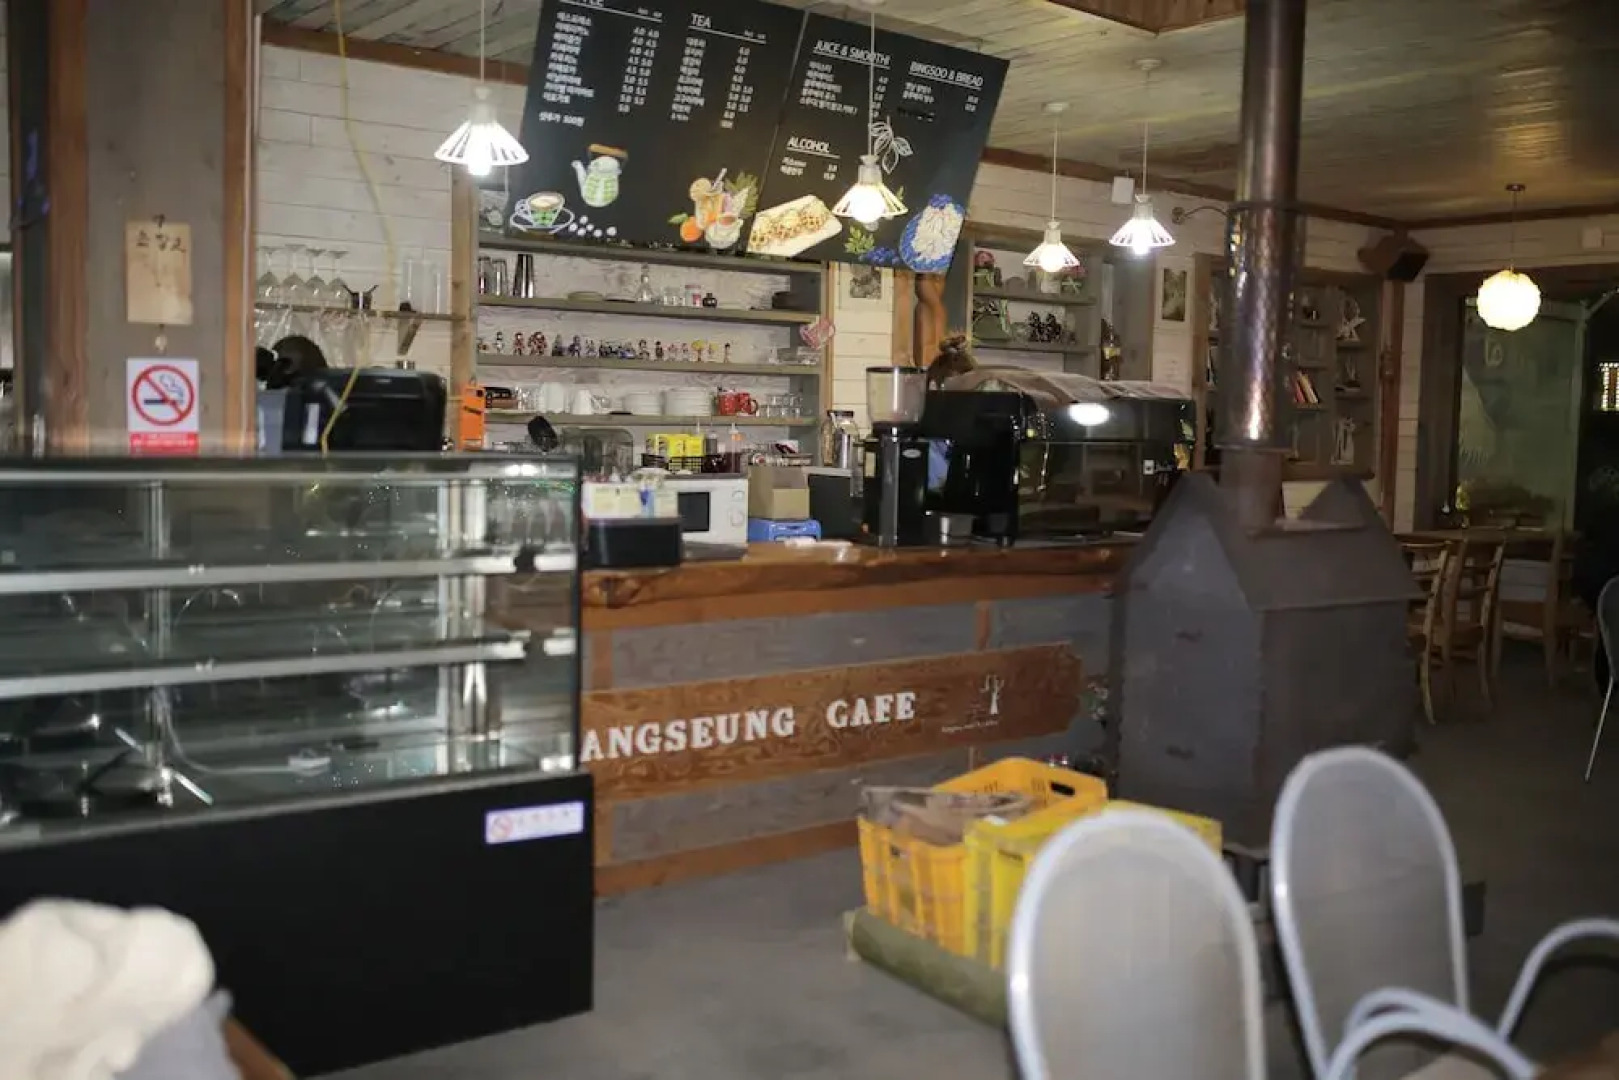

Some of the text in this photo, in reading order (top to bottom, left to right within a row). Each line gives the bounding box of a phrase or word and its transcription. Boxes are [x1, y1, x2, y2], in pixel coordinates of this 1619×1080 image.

[691, 12, 712, 28] TEA
[814, 40, 841, 54] JUICE
[841, 45, 849, 56] &
[909, 61, 948, 79] BINGSOO
[955, 71, 984, 87] BREAD
[787, 136, 830, 153] ALCOHOL
